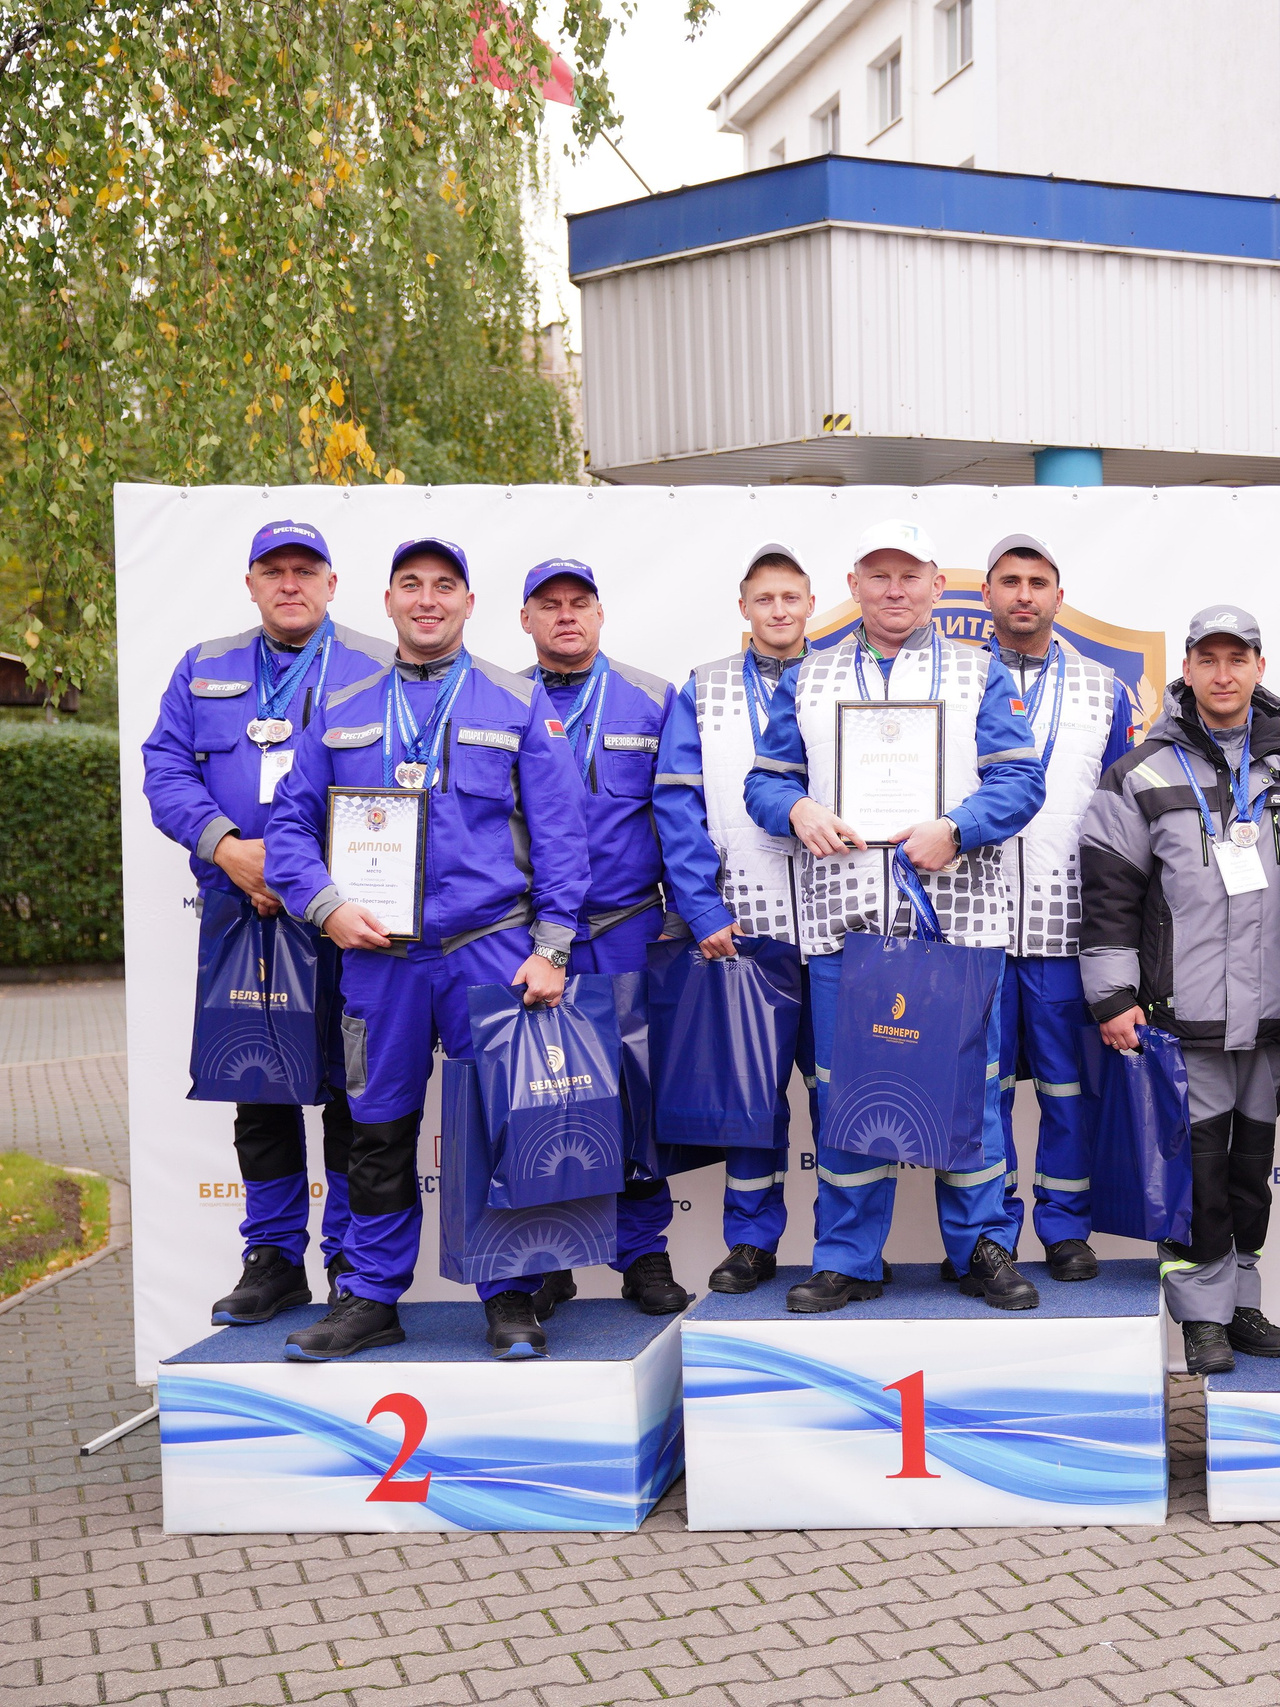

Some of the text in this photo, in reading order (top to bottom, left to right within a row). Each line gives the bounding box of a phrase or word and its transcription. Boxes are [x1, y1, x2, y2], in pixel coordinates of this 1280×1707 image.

[932, 615, 994, 639] ДИТЕ
[459, 728, 484, 742] АППАРАТ
[604, 736, 645, 748] БЕРЕЗОВСКАЯ
[860, 753, 919, 765] ДИПЛОМ
[348, 841, 402, 853] ДИПЛОМ
[872, 1023, 920, 1040] БЕЛЭНЕРГО
[529, 1074, 592, 1091] БЕЛЭНЕРГО
[882, 1370, 941, 1479] 1
[365, 1392, 432, 1503] 2
